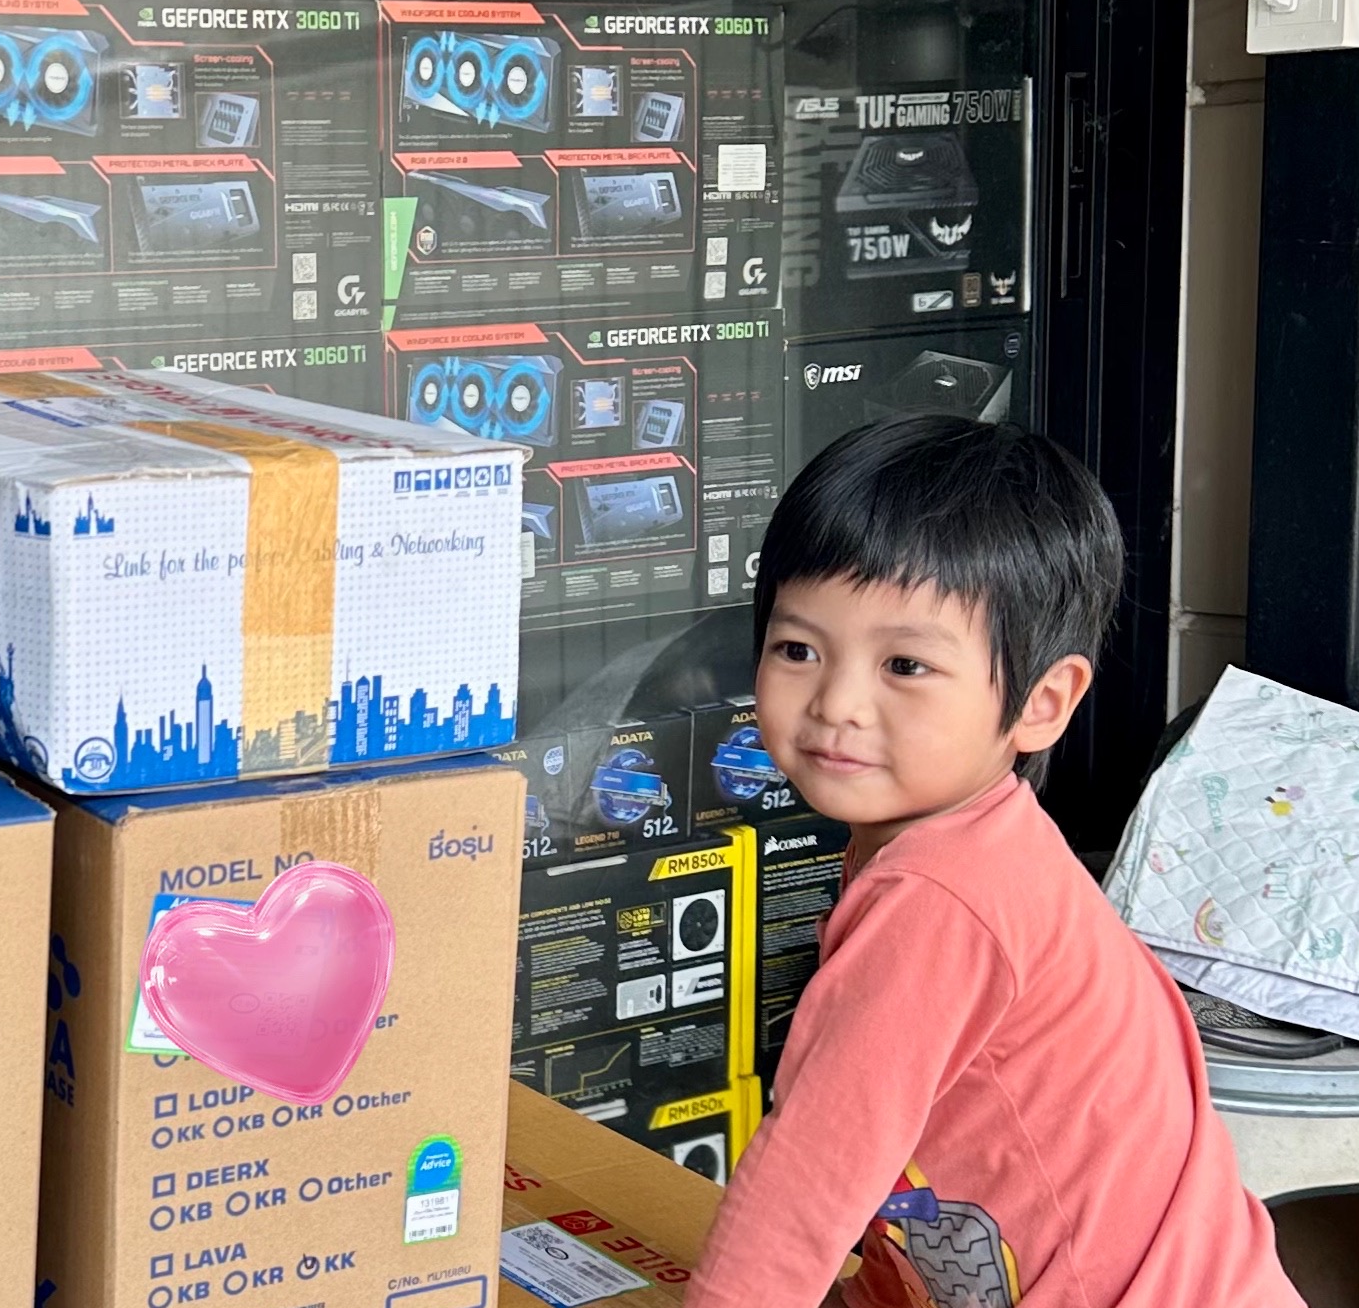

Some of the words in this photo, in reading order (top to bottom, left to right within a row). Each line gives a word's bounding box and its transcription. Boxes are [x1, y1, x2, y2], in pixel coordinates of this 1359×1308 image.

[161, 7, 241, 30] GEFORCE
[246, 9, 290, 30] RTX
[295, 10, 341, 30] 3060
[345, 11, 360, 31] Ti
[604, 15, 675, 35] GEFORCE
[679, 17, 710, 35] RTX
[715, 17, 753, 35] 3060
[756, 17, 769, 35] Ti
[795, 97, 839, 112] ASUS
[856, 95, 897, 130] TUF
[896, 103, 950, 128] GAMING
[952, 90, 1011, 125] 750W
[848, 233, 910, 263] 750W
[607, 324, 678, 348] GEFORCE
[681, 322, 712, 343] RTX
[716, 322, 754, 341] 3060
[757, 320, 769, 339] Ti
[173, 348, 256, 373] GEFORCE
[260, 346, 299, 369] RTX
[303, 345, 348, 367] 3060
[351, 343, 366, 364] Ti
[821, 364, 863, 384] msi
[103, 553, 152, 580] Link
[159, 555, 186, 581] for
[194, 546, 220, 571] the
[372, 542, 383, 558] &
[390, 529, 485, 565] Networking
[610, 731, 654, 746] ADATA
[762, 789, 791, 810] 512
[642, 816, 673, 838] 512
[428, 824, 494, 862] ชื่อรุ่น
[778, 835, 818, 851] CORSAIR
[188, 1085, 255, 1112] LOUP
[177, 1124, 205, 1143] KK
[238, 1114, 265, 1132] KB
[297, 1104, 323, 1121] KR
[357, 1090, 411, 1111] Other
[186, 1158, 270, 1191] DEERX
[179, 1204, 212, 1225] KB
[256, 1187, 287, 1207] KR
[327, 1171, 393, 1195] Other
[184, 1242, 247, 1271] LAVA
[177, 1281, 210, 1304] KB
[252, 1267, 284, 1287] KR
[324, 1251, 356, 1273] KK
